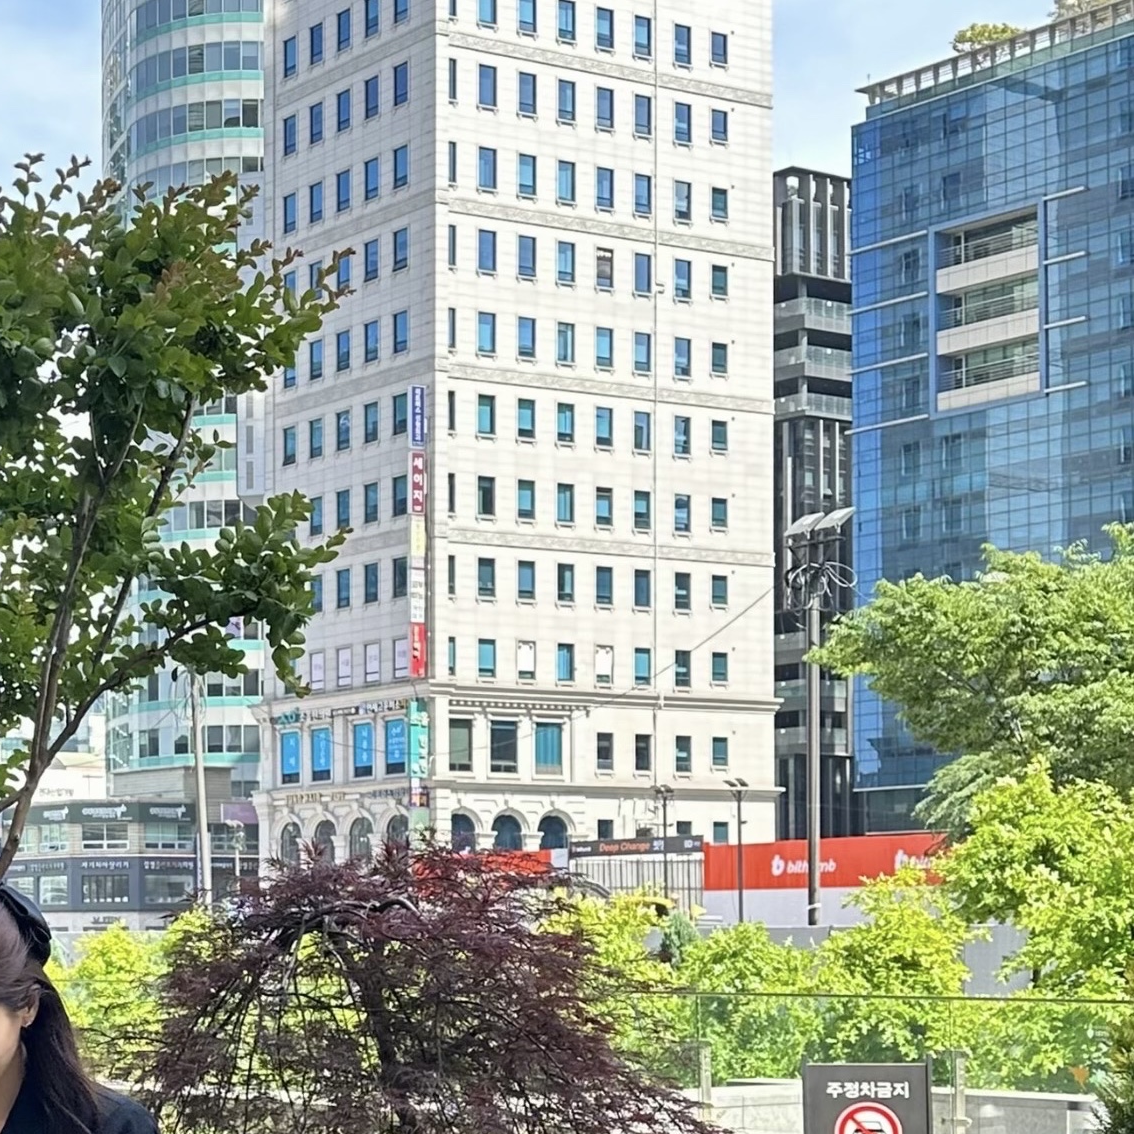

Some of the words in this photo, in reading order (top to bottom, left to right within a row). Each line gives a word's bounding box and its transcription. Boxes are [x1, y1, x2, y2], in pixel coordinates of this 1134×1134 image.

[599, 842, 619, 853] Deep
[620, 841, 651, 852] Change
[786, 858, 837, 874] bithmb
[826, 1081, 910, 1099] 주정차금지
